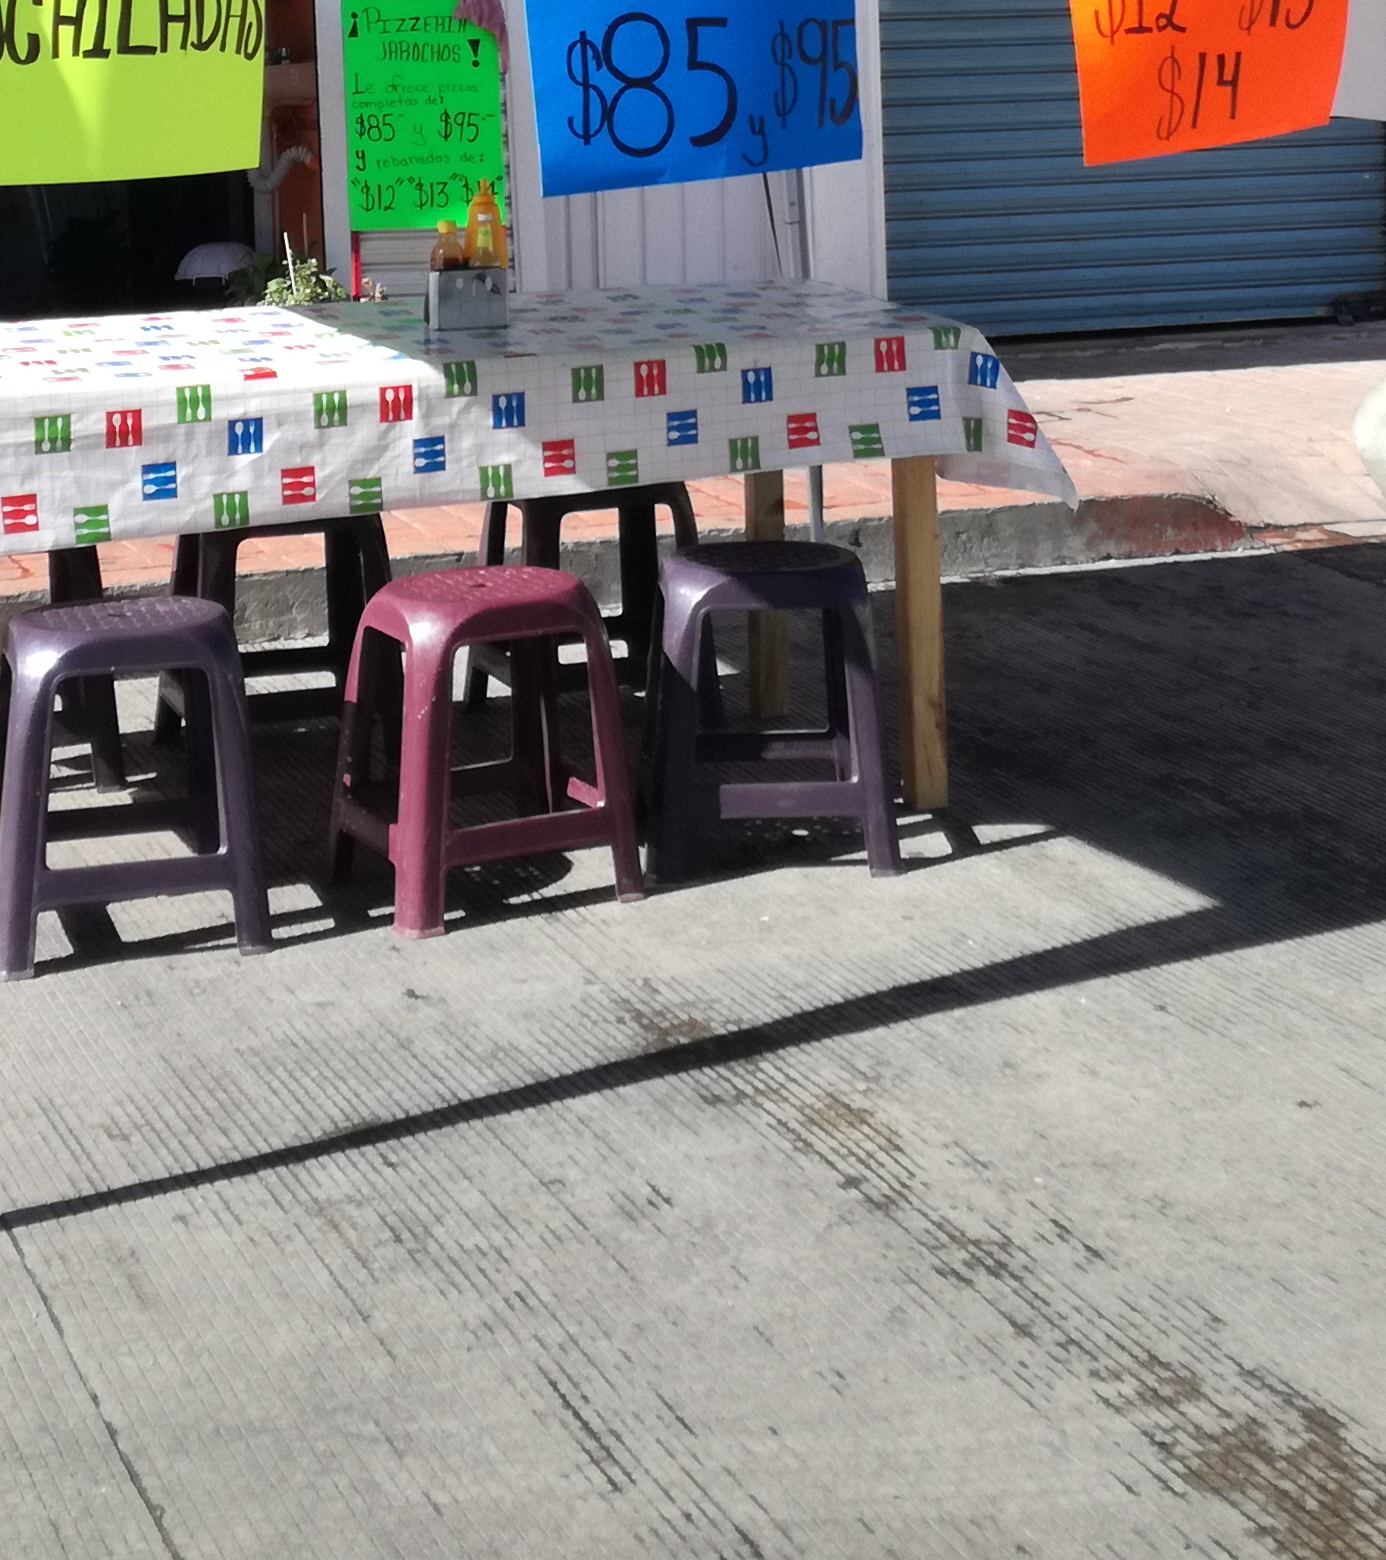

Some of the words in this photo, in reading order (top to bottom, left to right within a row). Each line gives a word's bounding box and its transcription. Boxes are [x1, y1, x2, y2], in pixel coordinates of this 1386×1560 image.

[353, 73, 373, 95] Le
[385, 75, 429, 93] ofrece
[438, 83, 479, 99] pizzas
[566, 11, 737, 158] $85
[742, 113, 768, 166] y
[771, 17, 859, 129] $95
[1157, 45, 1242, 141] $14
[352, 94, 418, 112] completas
[412, 124, 427, 146] y
[355, 149, 366, 171] y
[377, 148, 450, 169] rebanadas
